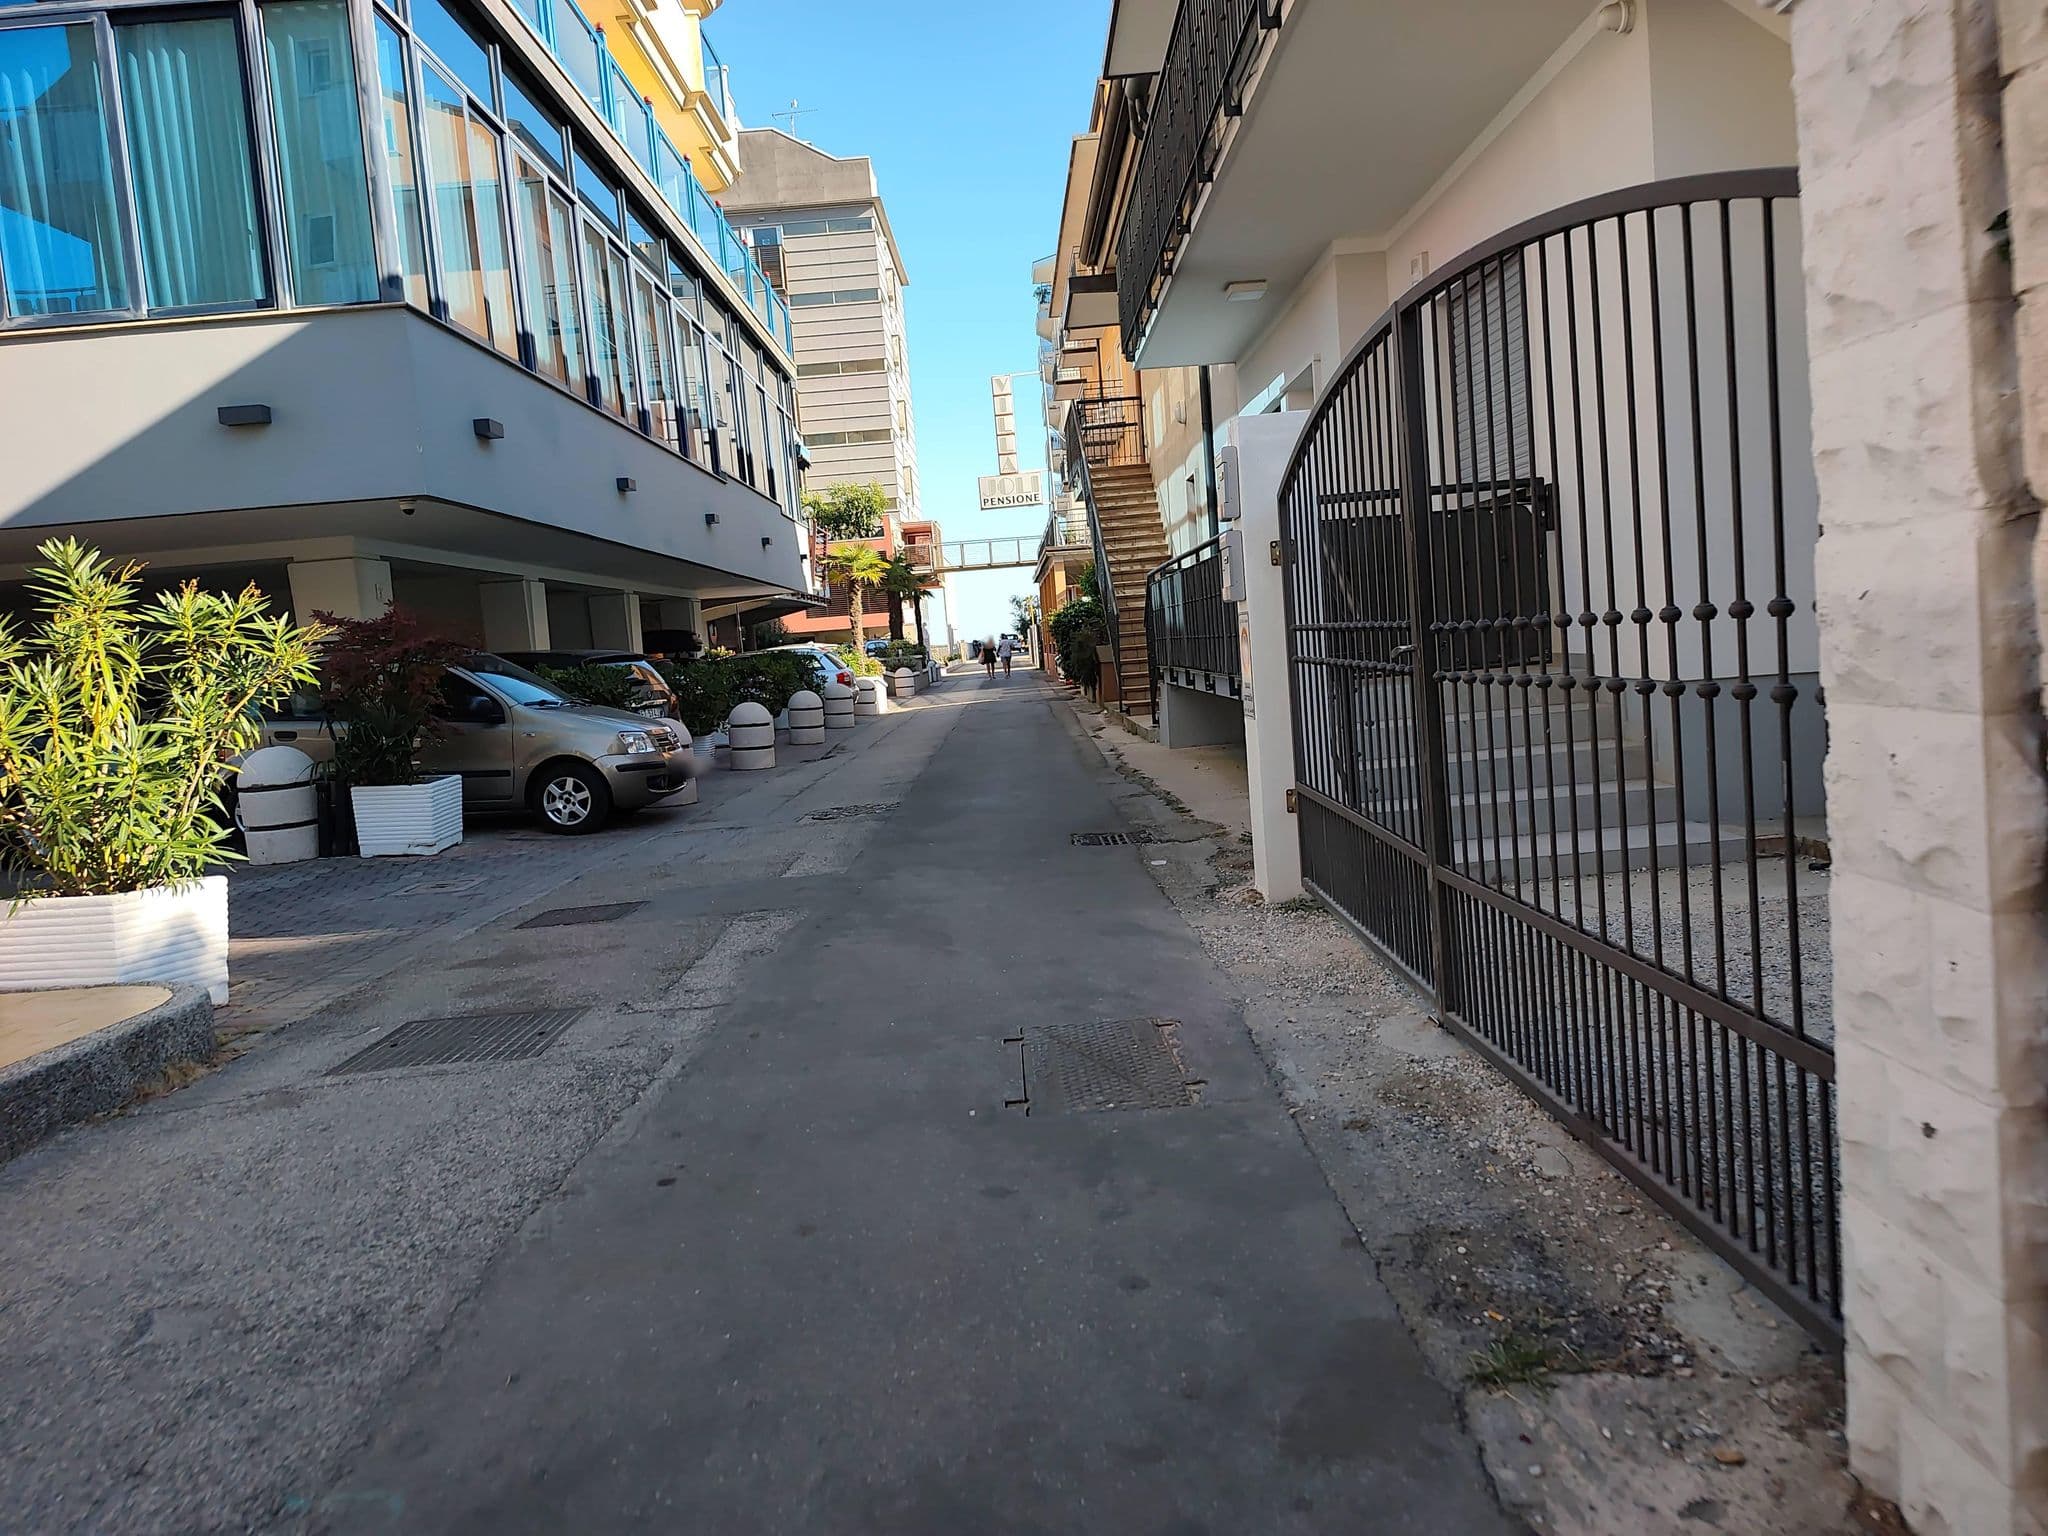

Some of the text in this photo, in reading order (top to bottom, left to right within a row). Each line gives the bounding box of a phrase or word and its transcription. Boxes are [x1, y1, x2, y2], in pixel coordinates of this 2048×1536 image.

[994, 378, 1016, 472] VILLA
[982, 475, 1040, 497] JOLI
[983, 493, 1040, 506] PENSIONE
